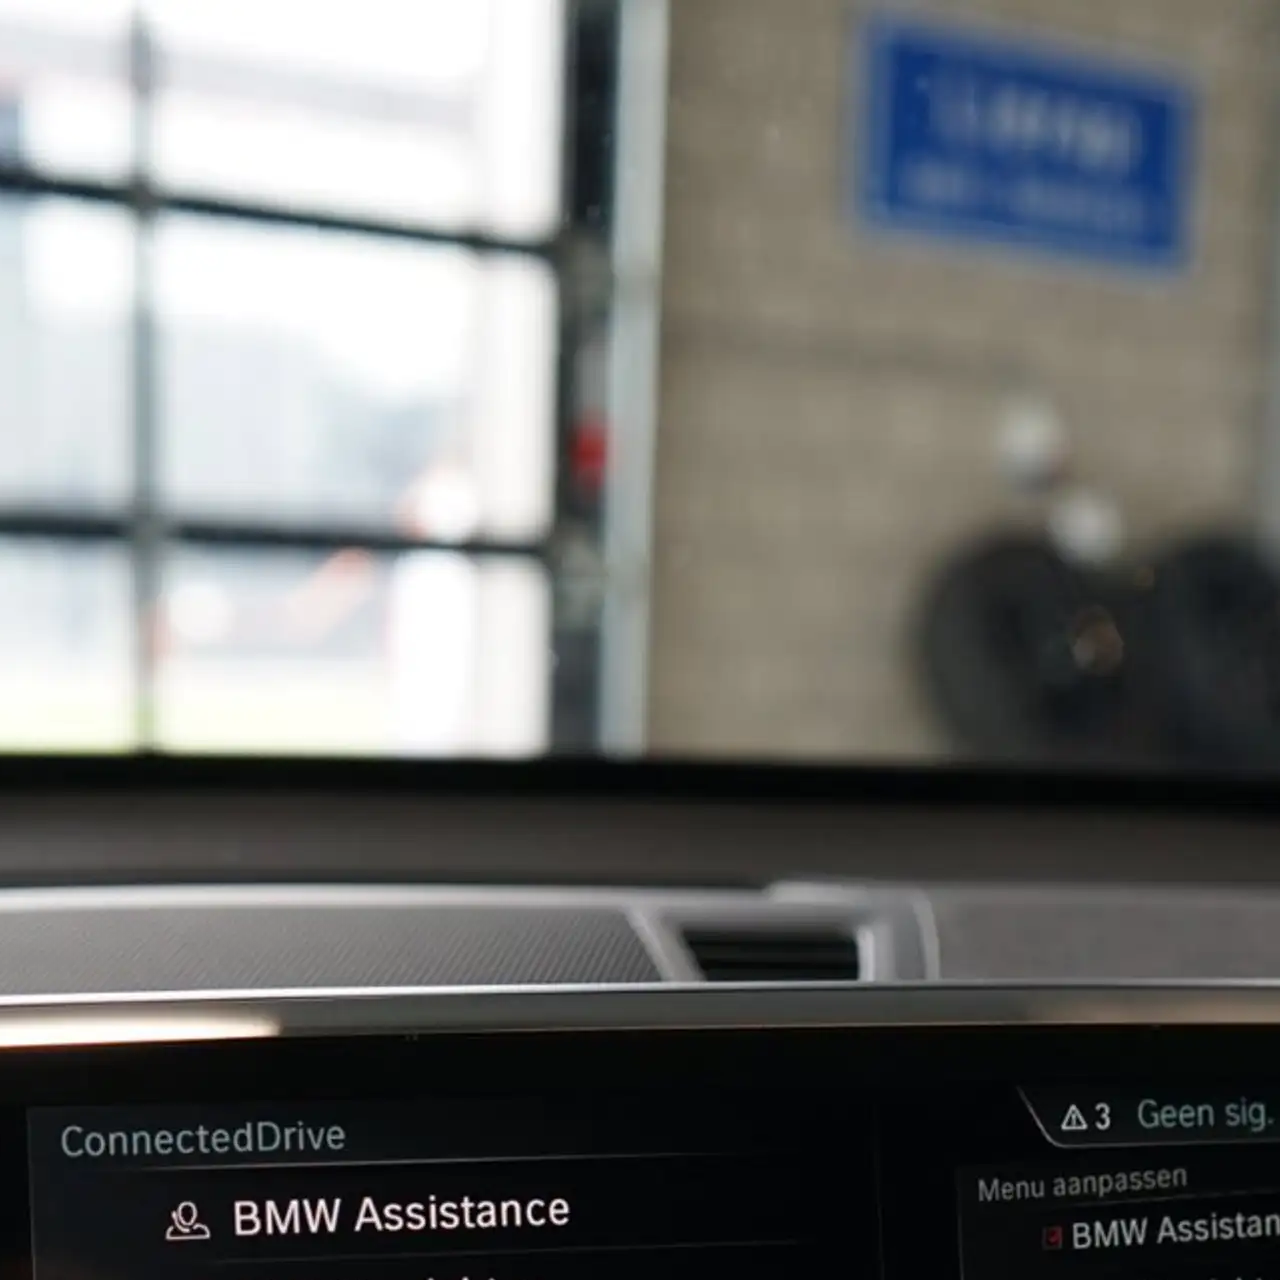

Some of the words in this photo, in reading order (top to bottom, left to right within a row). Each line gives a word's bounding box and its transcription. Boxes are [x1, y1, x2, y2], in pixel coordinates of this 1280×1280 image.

[1095, 1102, 1111, 1131] 3
[1137, 1098, 1215, 1129] Geen
[1225, 1097, 1274, 1133] sig.
[61, 1120, 346, 1157] ConnectedDrive
[978, 1177, 1045, 1202] Menu
[1053, 1168, 1187, 1198] aanpassen
[234, 1197, 341, 1236] BMW
[354, 1194, 570, 1232] Assistance
[1072, 1217, 1148, 1250] BMW
